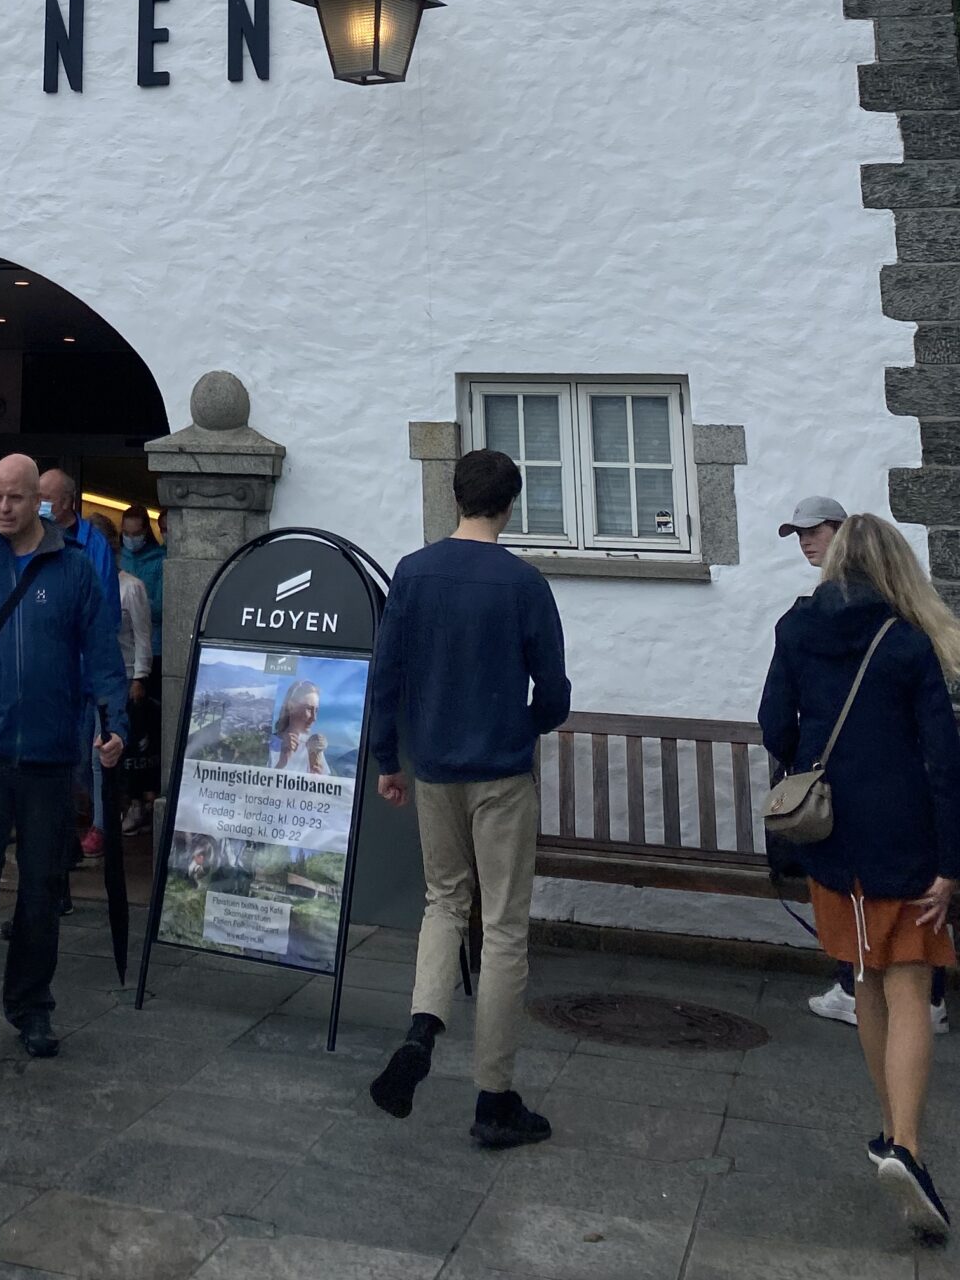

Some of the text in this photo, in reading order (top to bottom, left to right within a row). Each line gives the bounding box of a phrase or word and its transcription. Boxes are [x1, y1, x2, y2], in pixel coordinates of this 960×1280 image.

[241, 607, 338, 633] FLØYEN
[192, 762, 342, 796] Åpningstider Fløibanen
[198, 787, 236, 803] Mandag
[299, 800, 331, 814] 08-22
[201, 804, 235, 819] Fredag
[291, 815, 322, 830] 09-23
[271, 828, 302, 842] 09-22
